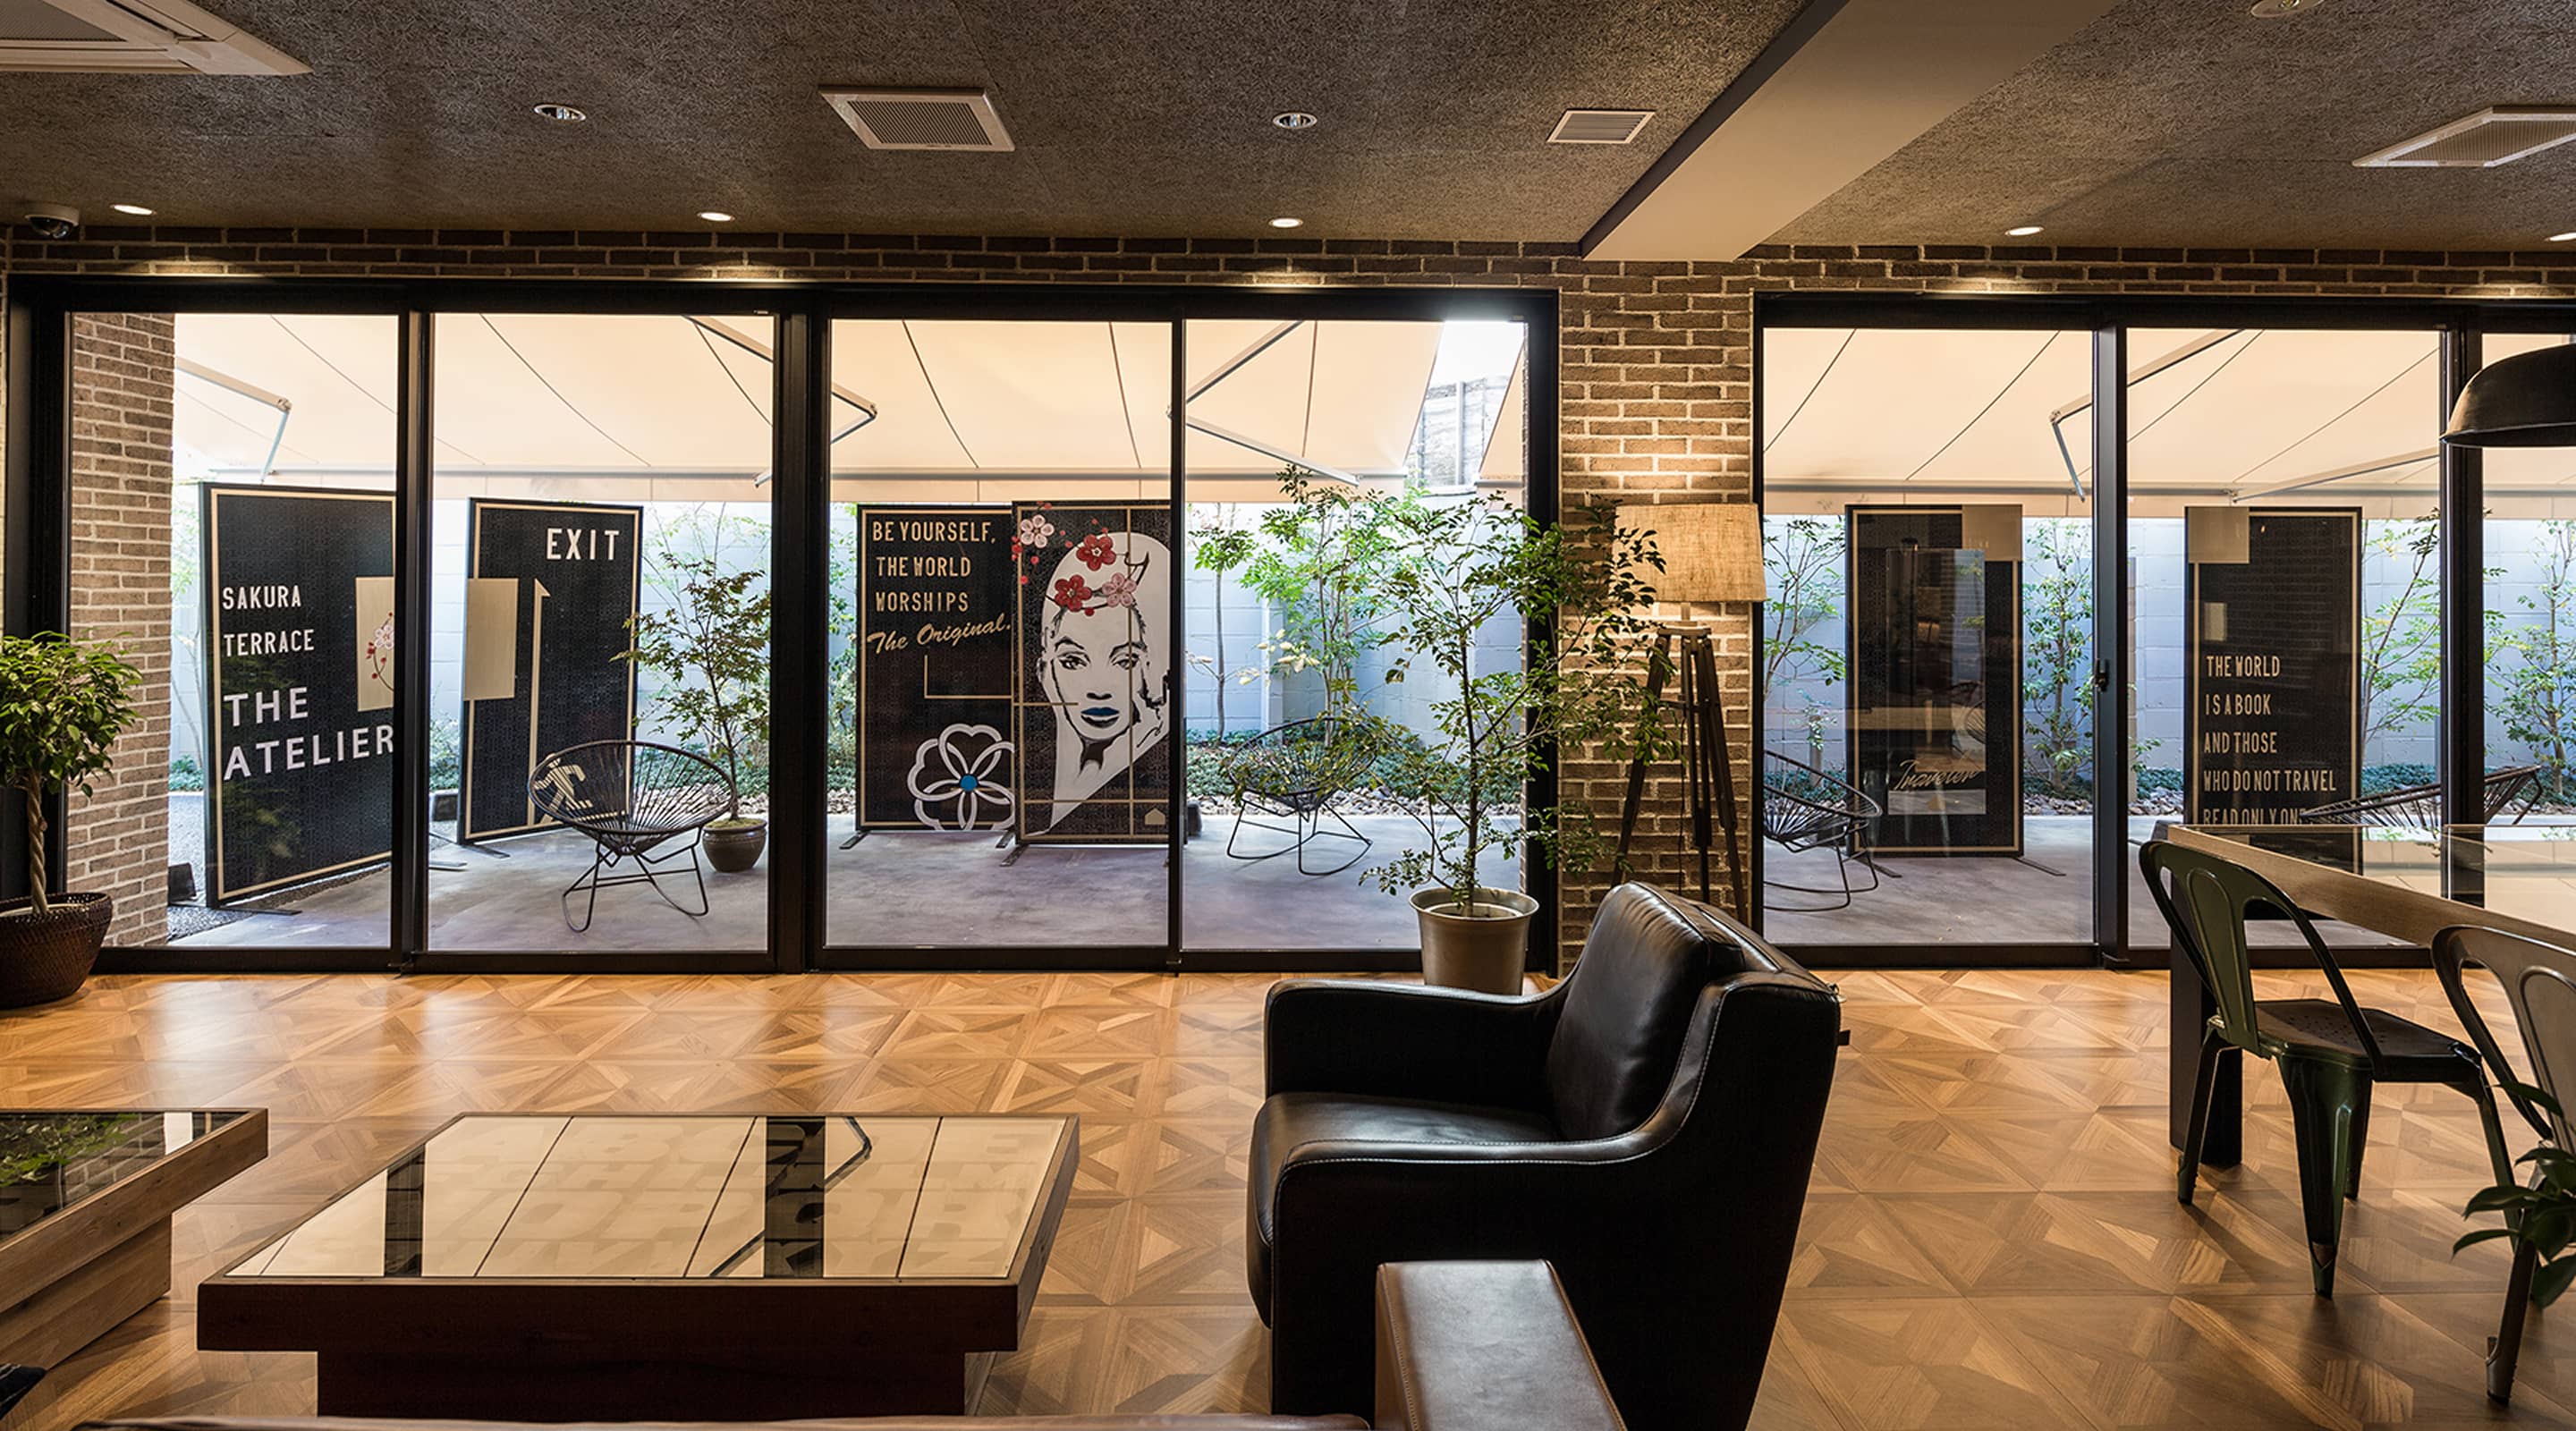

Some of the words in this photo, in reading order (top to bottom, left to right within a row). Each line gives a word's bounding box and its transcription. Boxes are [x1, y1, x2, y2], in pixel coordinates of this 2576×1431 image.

[873, 521, 894, 540] BE
[900, 522, 995, 543] YOURSELF,
[547, 529, 619, 560] EXIT
[877, 557, 908, 576] THE
[914, 557, 970, 576] WORLD
[223, 586, 301, 609] SAKURA
[877, 592, 968, 611] WORSHIPS
[224, 630, 314, 656] TERRACE
[868, 631, 907, 653] The
[917, 613, 1011, 647] Original.
[2207, 656, 2231, 676] THE
[2236, 656, 2279, 676] WORLD
[224, 687, 308, 726] THE
[2207, 694, 2220, 715] IS
[2224, 694, 2232, 715] A
[2236, 694, 2270, 715] BOOK
[225, 724, 393, 780] ATELIER
[2204, 732, 2229, 753] AND
[2233, 732, 2276, 753] THOSE
[2204, 771, 2229, 791] WHO
[2233, 770, 2250, 791] DO
[2255, 770, 2280, 791] NOT
[2284, 770, 2336, 791] TRAVEL
[2204, 809, 2237, 824] READ
